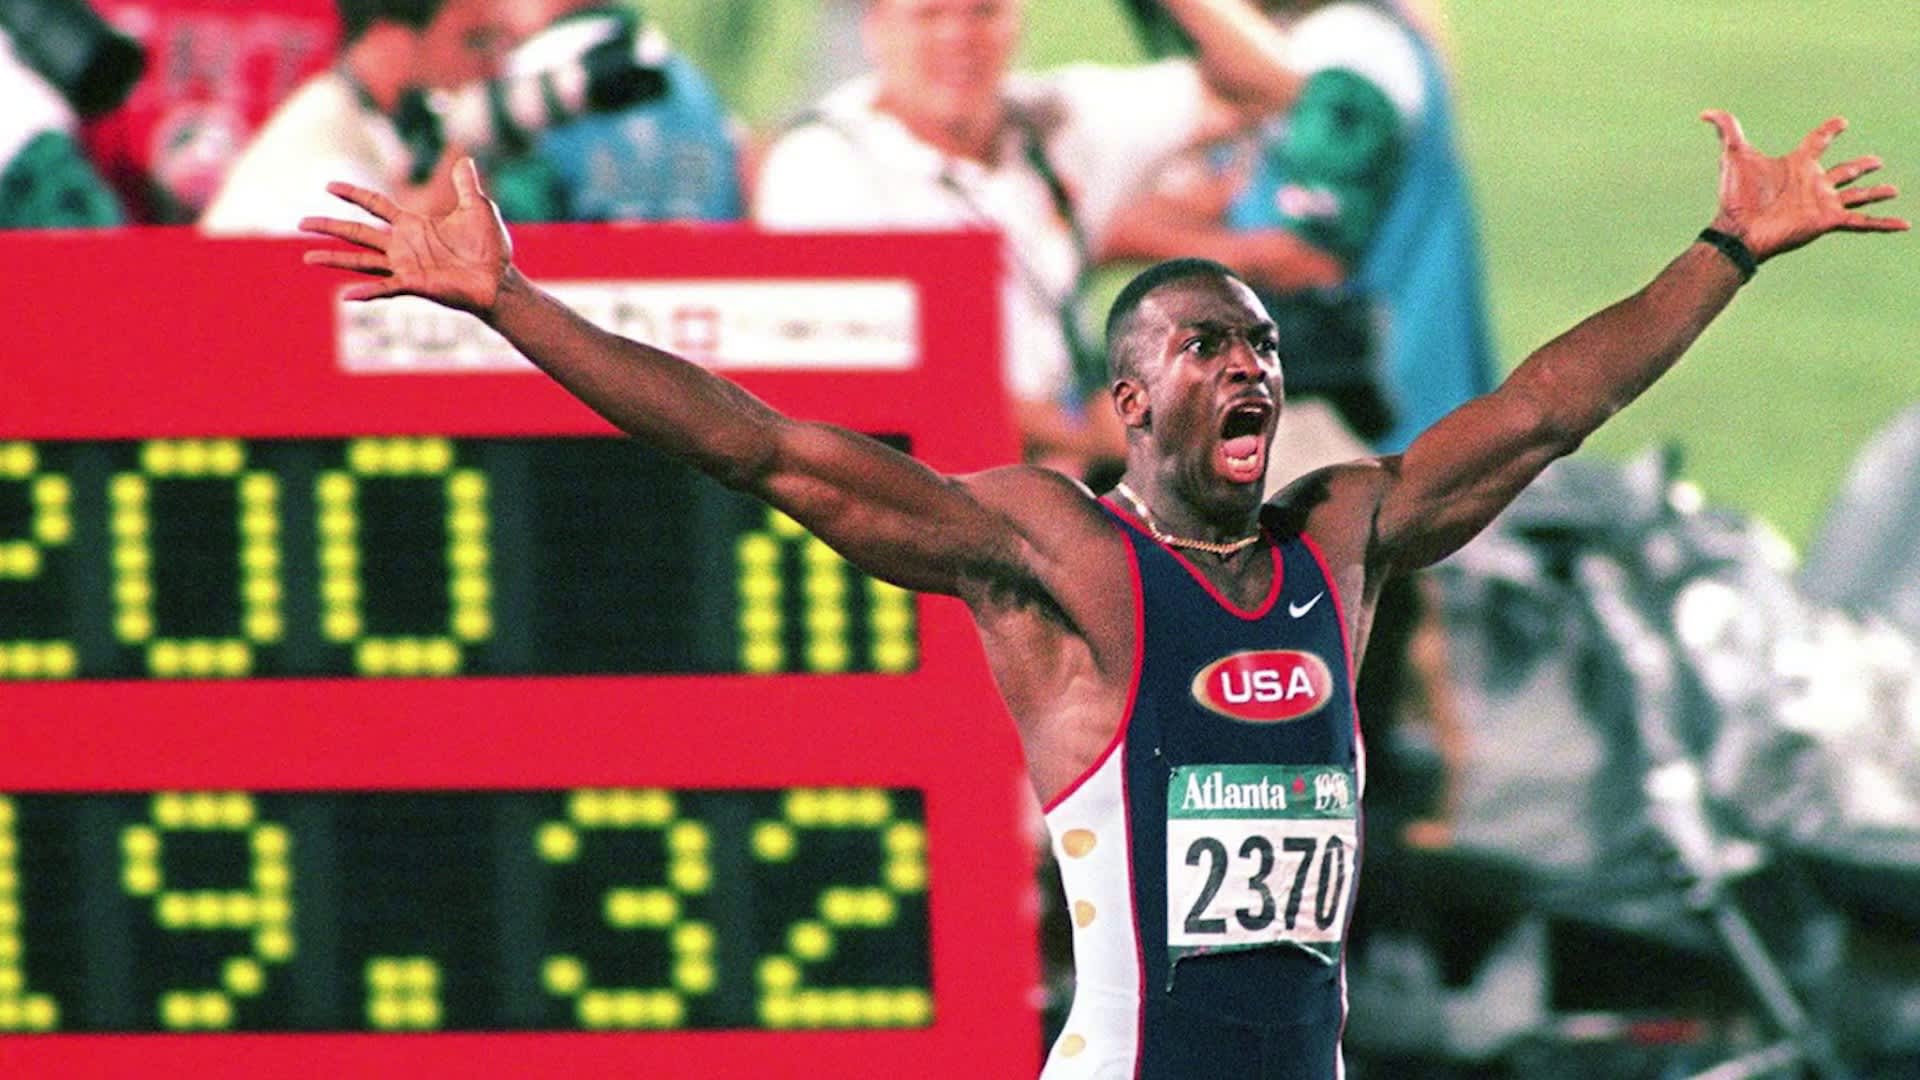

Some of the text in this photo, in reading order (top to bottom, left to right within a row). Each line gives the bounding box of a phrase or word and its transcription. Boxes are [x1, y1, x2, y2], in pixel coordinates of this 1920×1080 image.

[1220, 666, 1316, 705] USA
[1181, 771, 1287, 811] Atlanta
[1184, 834, 1346, 934] 2370
